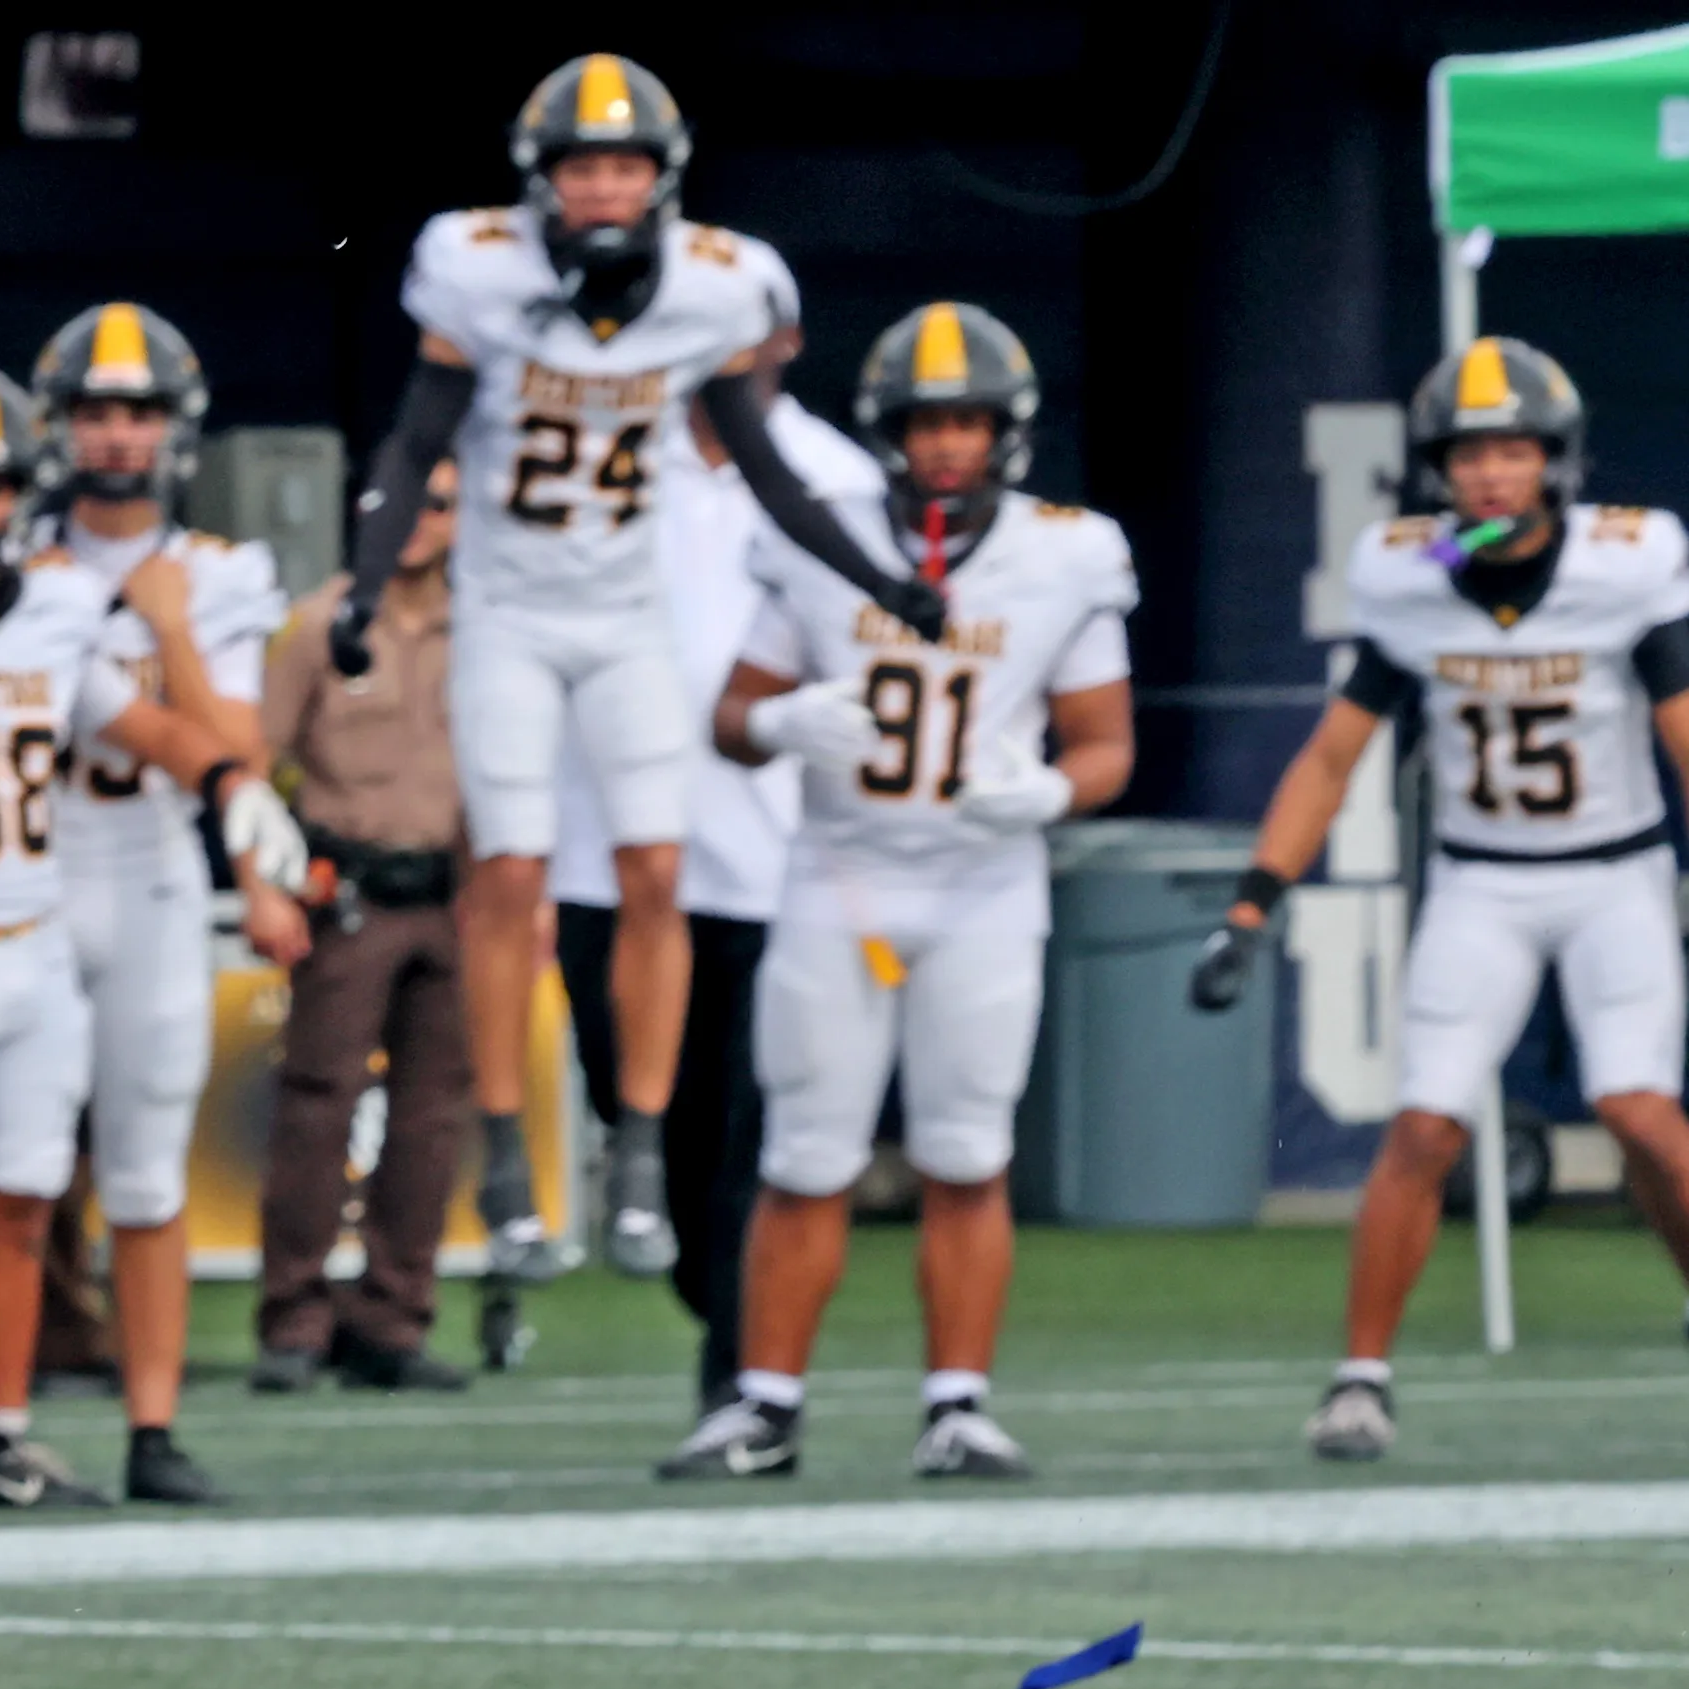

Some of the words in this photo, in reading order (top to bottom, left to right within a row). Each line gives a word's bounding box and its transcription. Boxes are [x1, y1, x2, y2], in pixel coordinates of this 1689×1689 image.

[503, 412, 657, 528] 24
[857, 660, 983, 801] 91
[1455, 699, 1581, 818] 15
